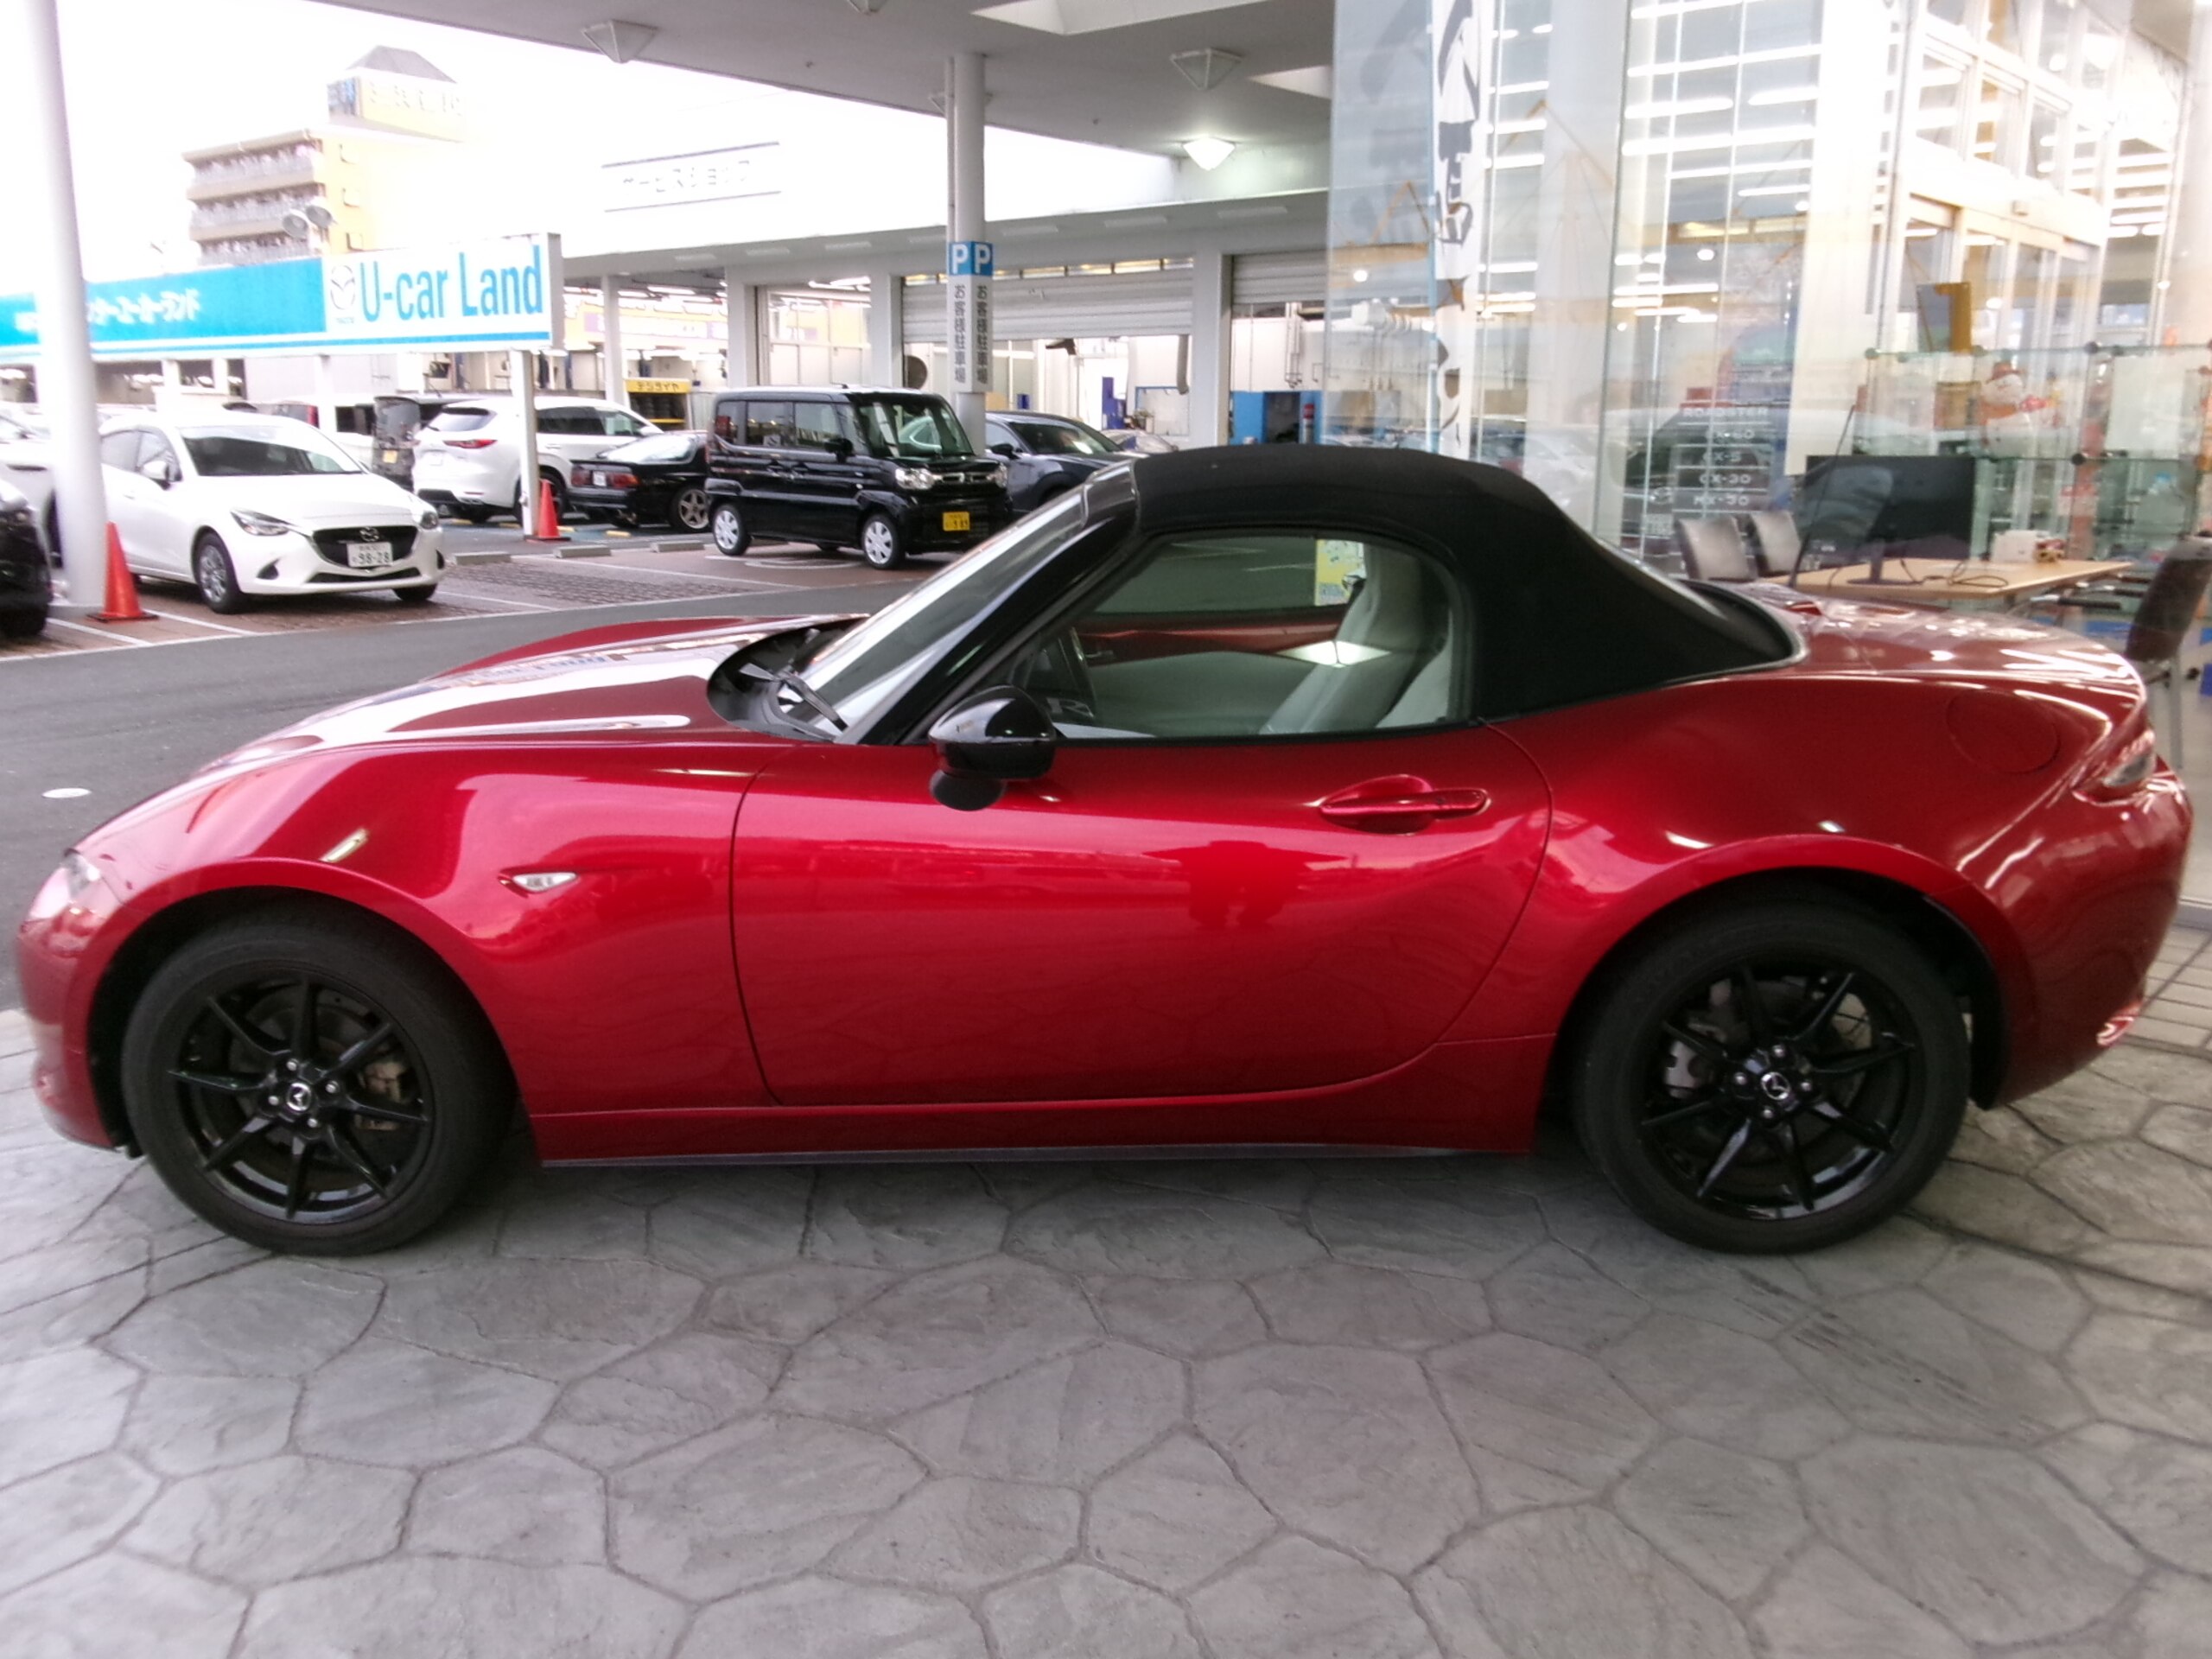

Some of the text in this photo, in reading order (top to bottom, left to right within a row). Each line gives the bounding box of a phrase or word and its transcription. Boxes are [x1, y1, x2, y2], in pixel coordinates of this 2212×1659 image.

[952, 245, 968, 274] P
[975, 244, 990, 274] P
[359, 245, 543, 322] U-car Land
[1699, 474, 1751, 484] CX-30
